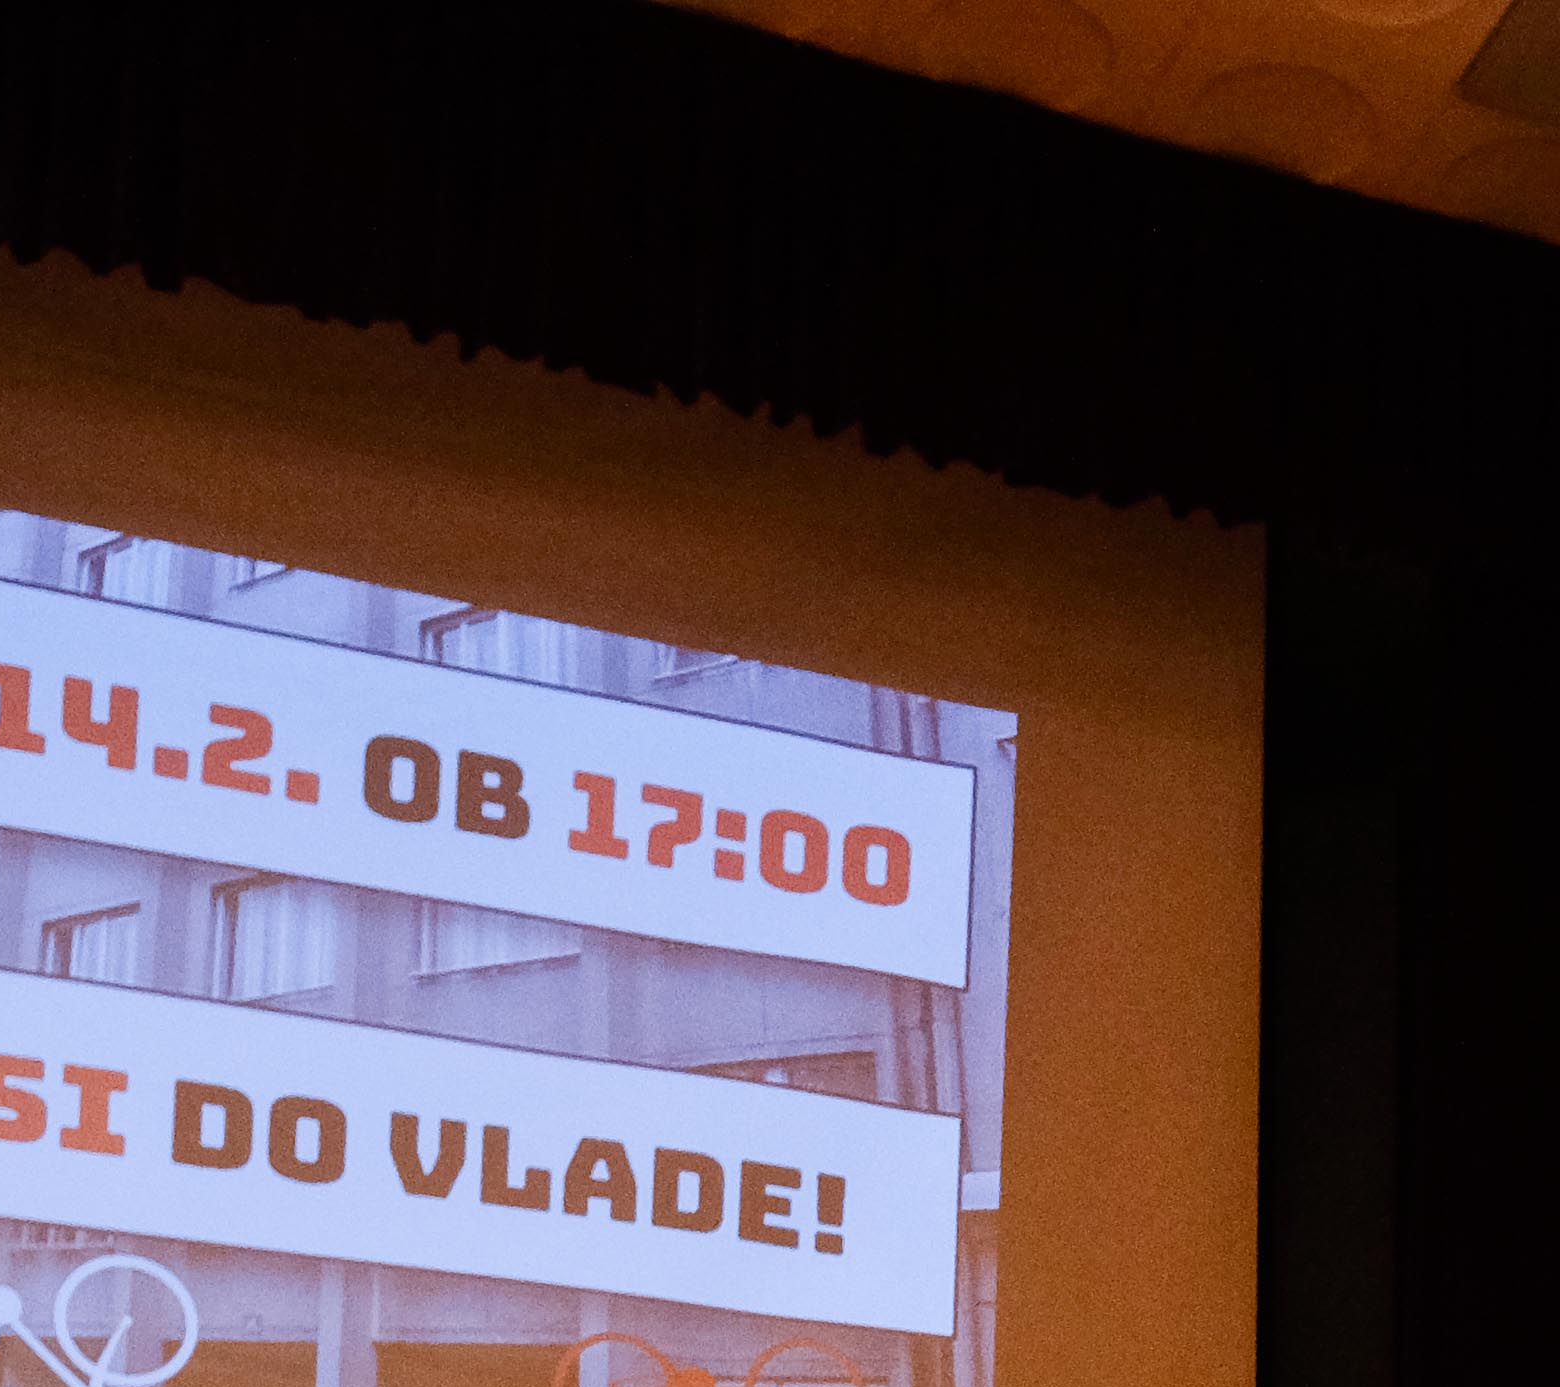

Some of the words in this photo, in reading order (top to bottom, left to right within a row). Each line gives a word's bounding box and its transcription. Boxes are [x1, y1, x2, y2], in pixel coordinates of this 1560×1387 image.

[364, 736, 530, 839] OB
[569, 772, 910, 906] 17:00
[173, 1081, 346, 1183] DO
[390, 1113, 845, 1254] VLADE!
